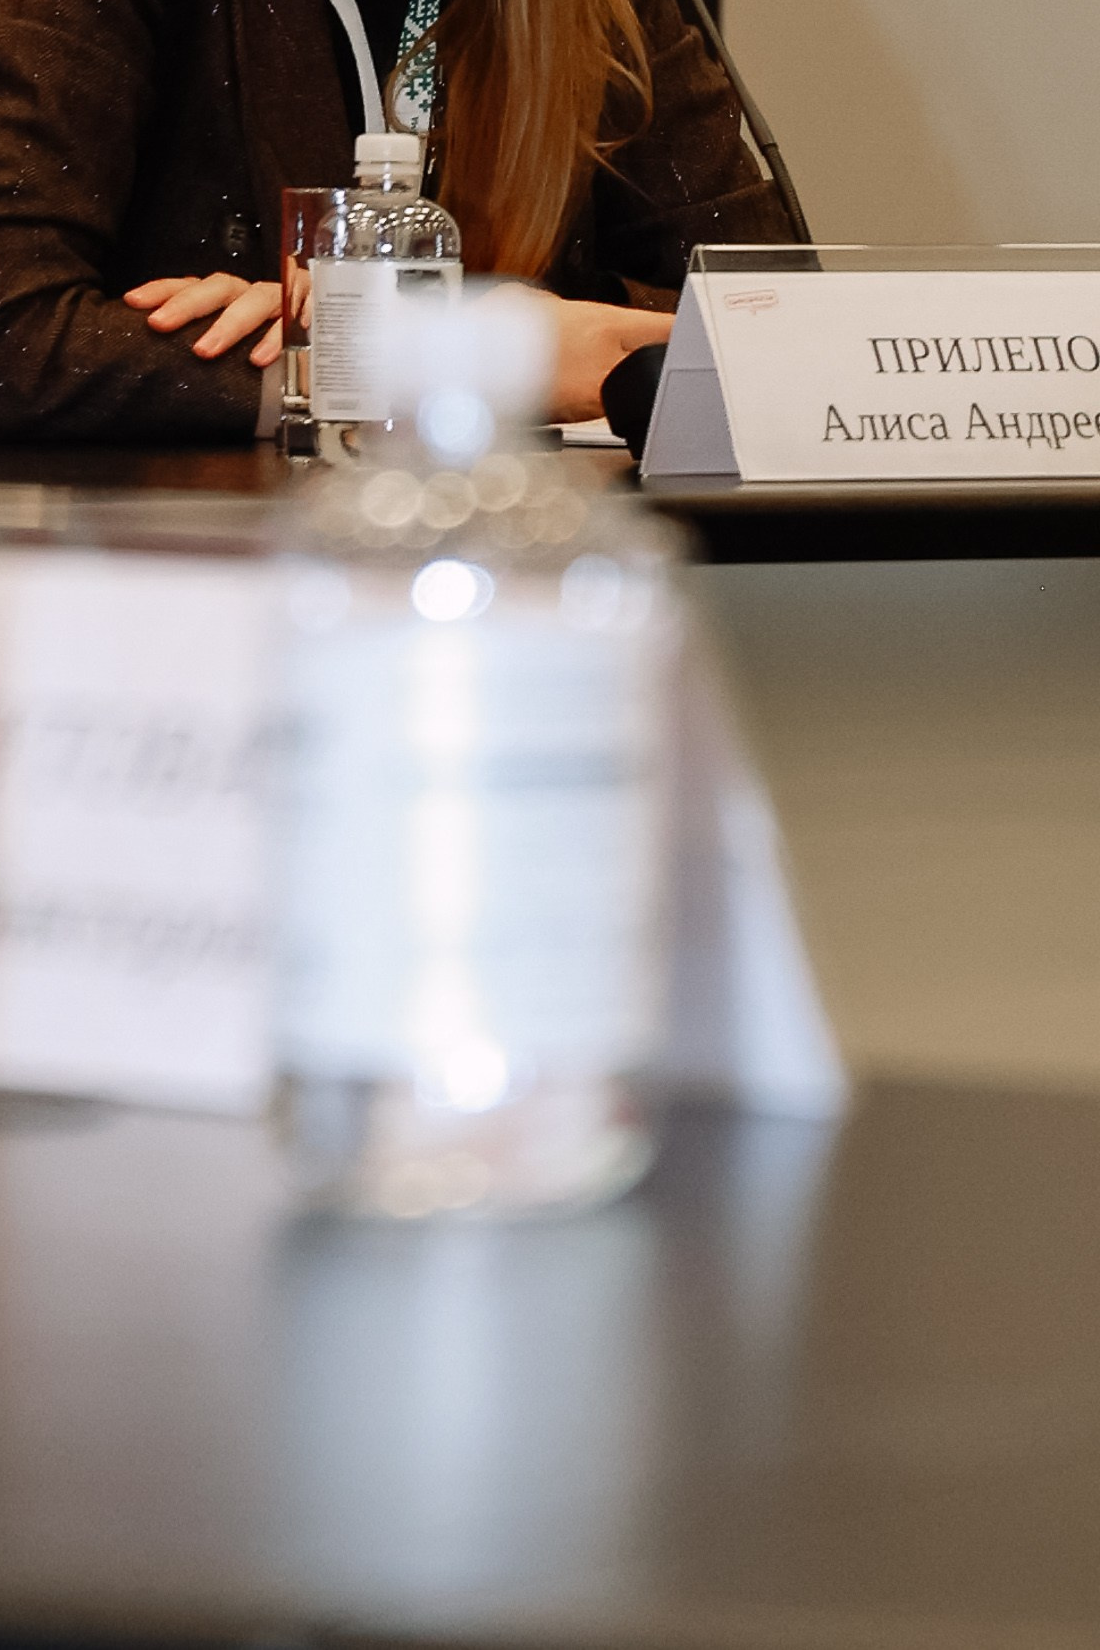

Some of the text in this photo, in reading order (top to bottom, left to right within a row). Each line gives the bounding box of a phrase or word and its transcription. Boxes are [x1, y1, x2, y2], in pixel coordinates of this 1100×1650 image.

[868, 335, 1100, 374] ПРИЛЕПО
[822, 402, 1100, 449] Алиса Андре
